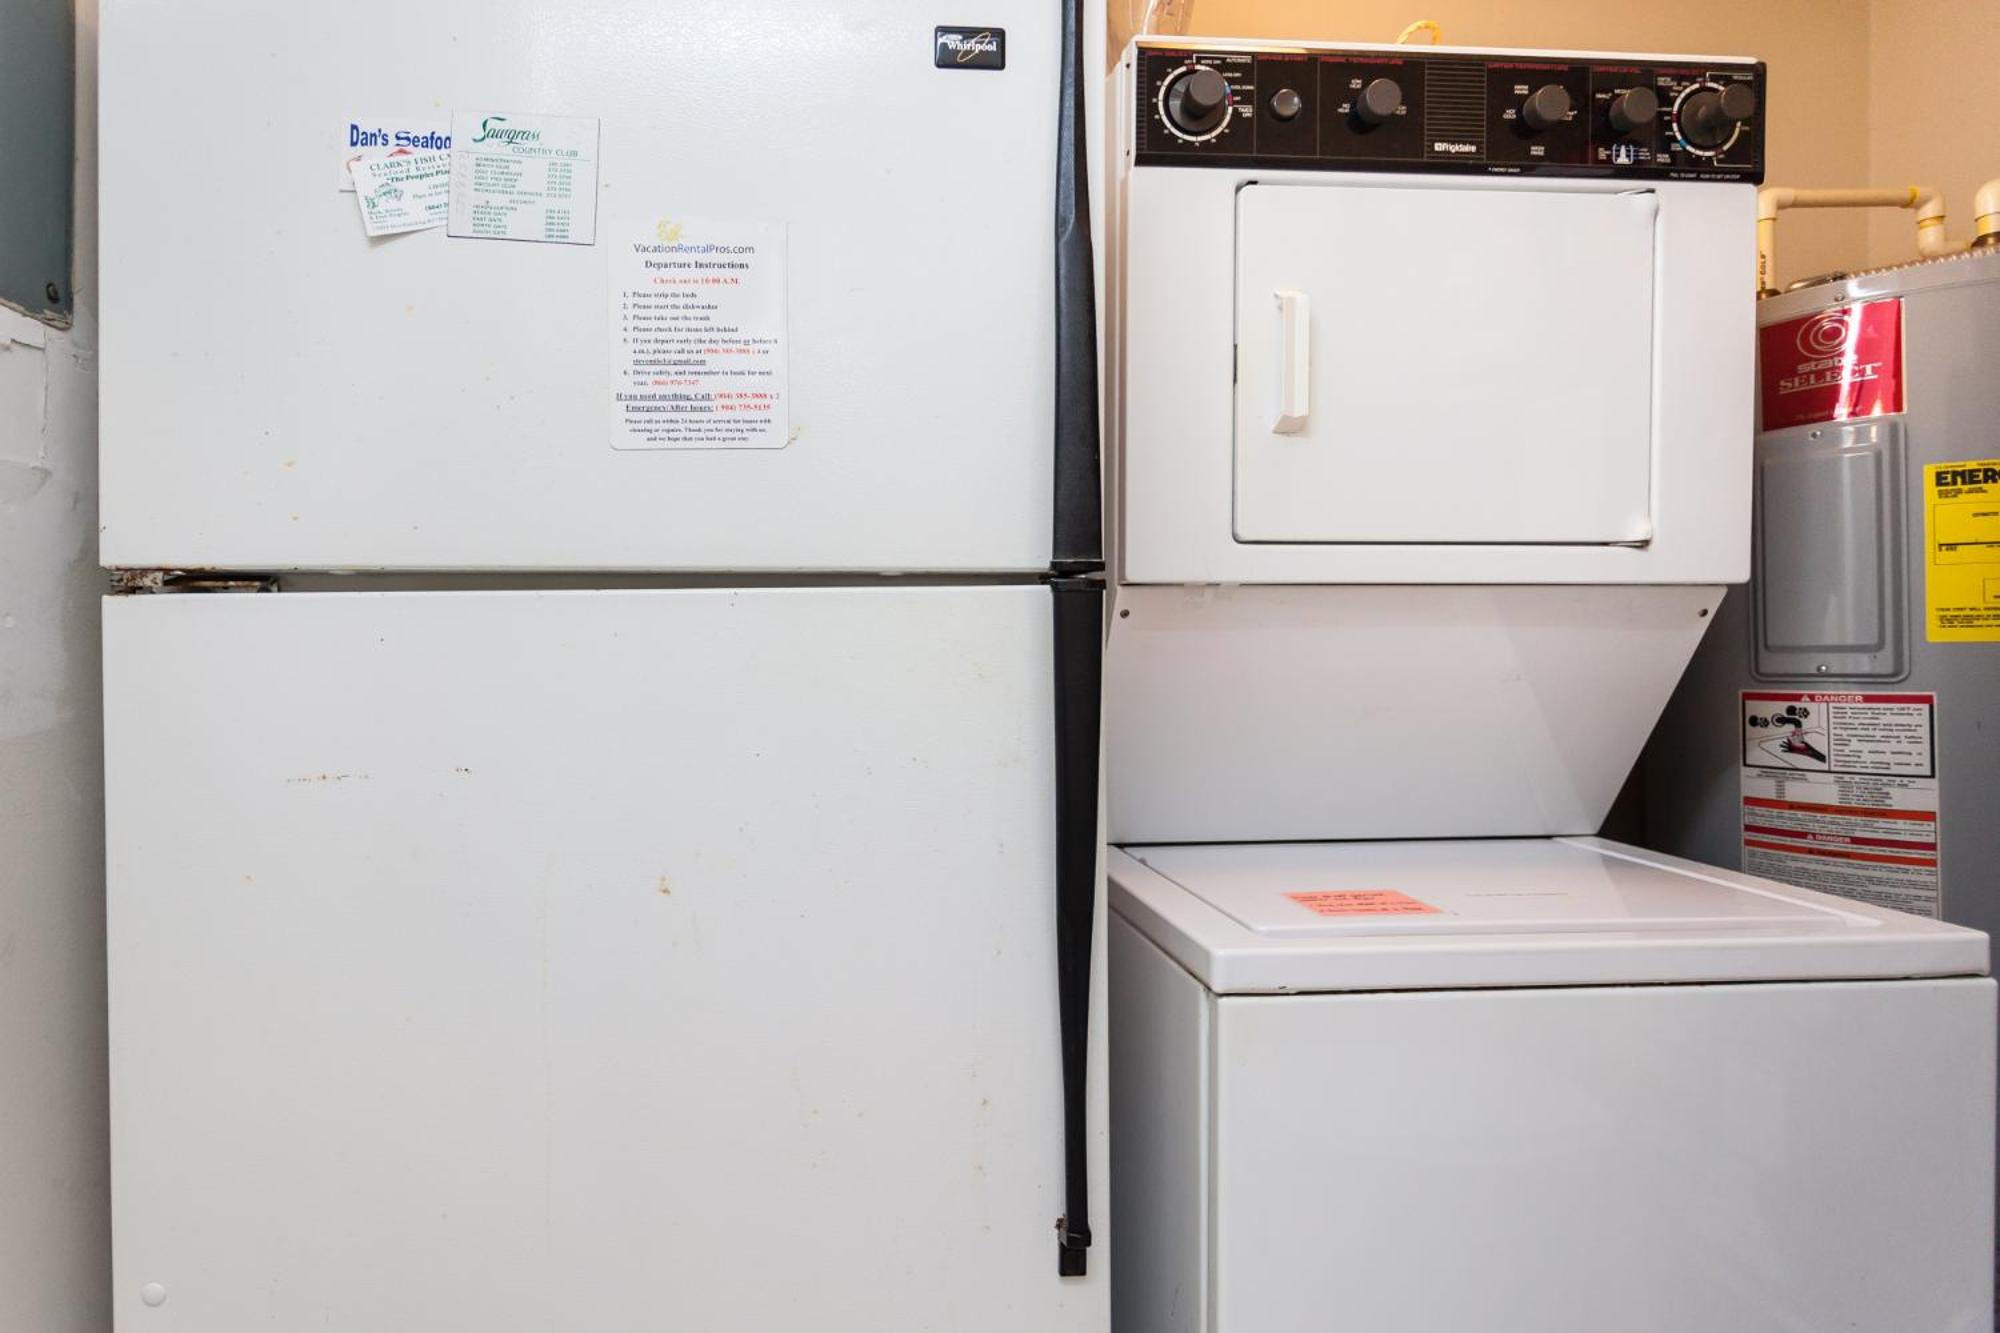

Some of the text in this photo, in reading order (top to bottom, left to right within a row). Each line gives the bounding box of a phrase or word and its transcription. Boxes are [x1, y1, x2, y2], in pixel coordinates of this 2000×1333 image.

[947, 40, 997, 54] Whirlpool
[350, 123, 390, 148] Dan's
[472, 116, 541, 145] Sawgrass
[511, 146, 579, 157] COUNTRY CLUB
[633, 243, 755, 255] VacationRentalPros.com
[645, 260, 750, 271] Departure Instructions
[1779, 361, 1883, 391] SELECT
[1815, 695, 1864, 703] DANGER
